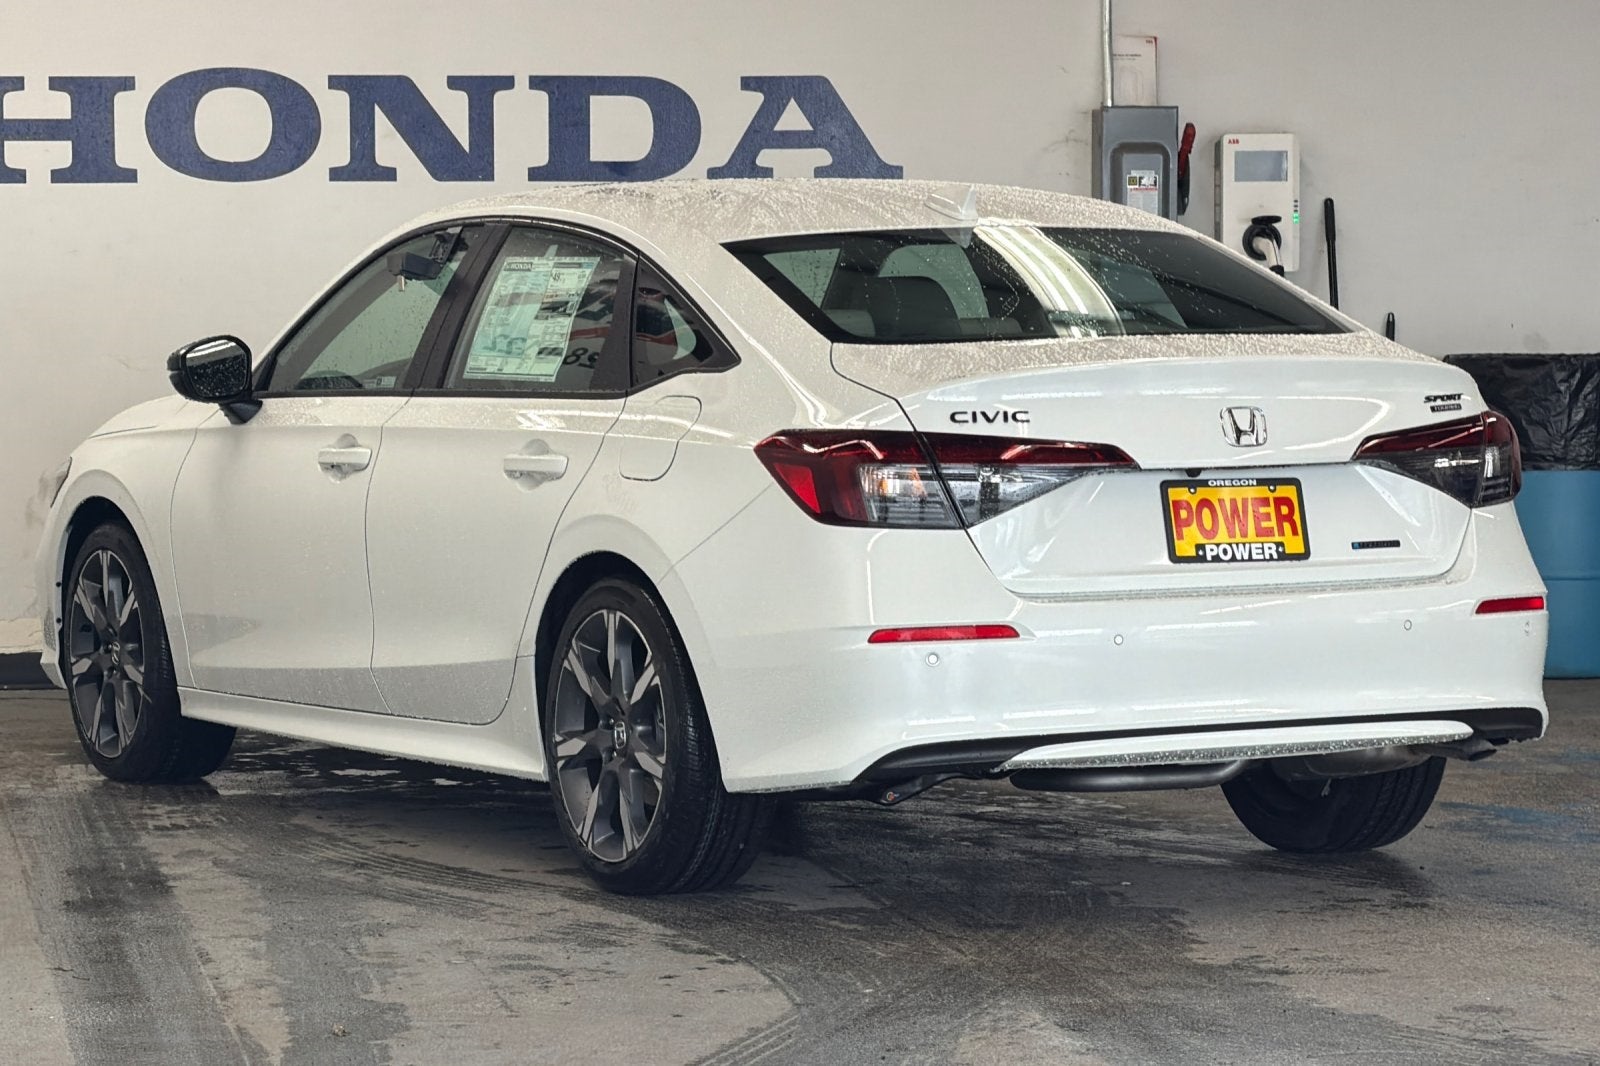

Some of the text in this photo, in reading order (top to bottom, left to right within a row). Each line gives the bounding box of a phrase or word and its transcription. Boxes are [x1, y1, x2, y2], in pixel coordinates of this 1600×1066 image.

[0, 67, 903, 184] HONDA
[510, 262, 532, 271] HONDA
[1424, 393, 1464, 403] SPORT
[949, 410, 1031, 424] CIVIC
[1171, 496, 1299, 541] POWER
[1204, 542, 1278, 561] POWER
